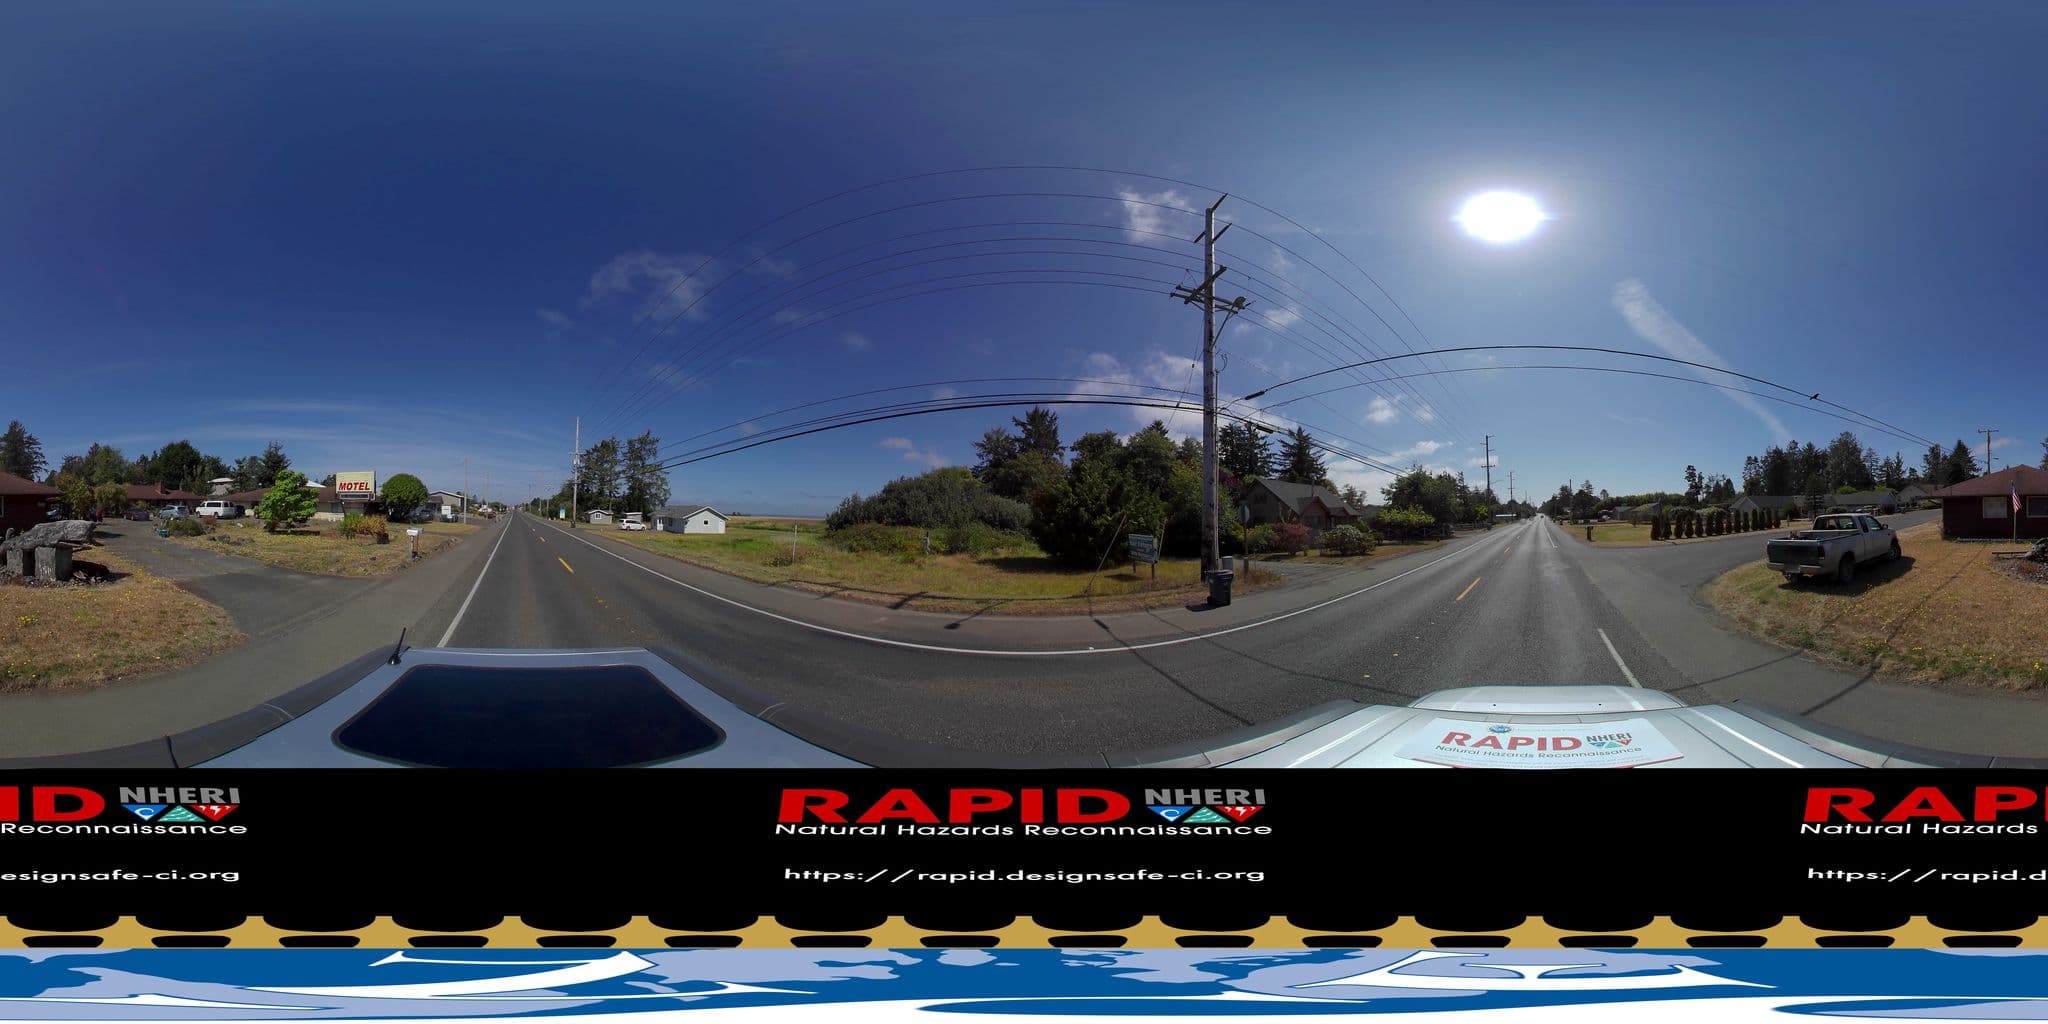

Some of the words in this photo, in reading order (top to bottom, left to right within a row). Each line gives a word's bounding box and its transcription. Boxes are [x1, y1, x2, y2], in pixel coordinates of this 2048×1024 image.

[339, 482, 370, 490] MOTEL
[1441, 731, 1581, 751] RAPID
[1586, 732, 1632, 743] NHERI
[1435, 745, 1479, 755] Natural
[1538, 747, 1642, 758] Reconnaissance
